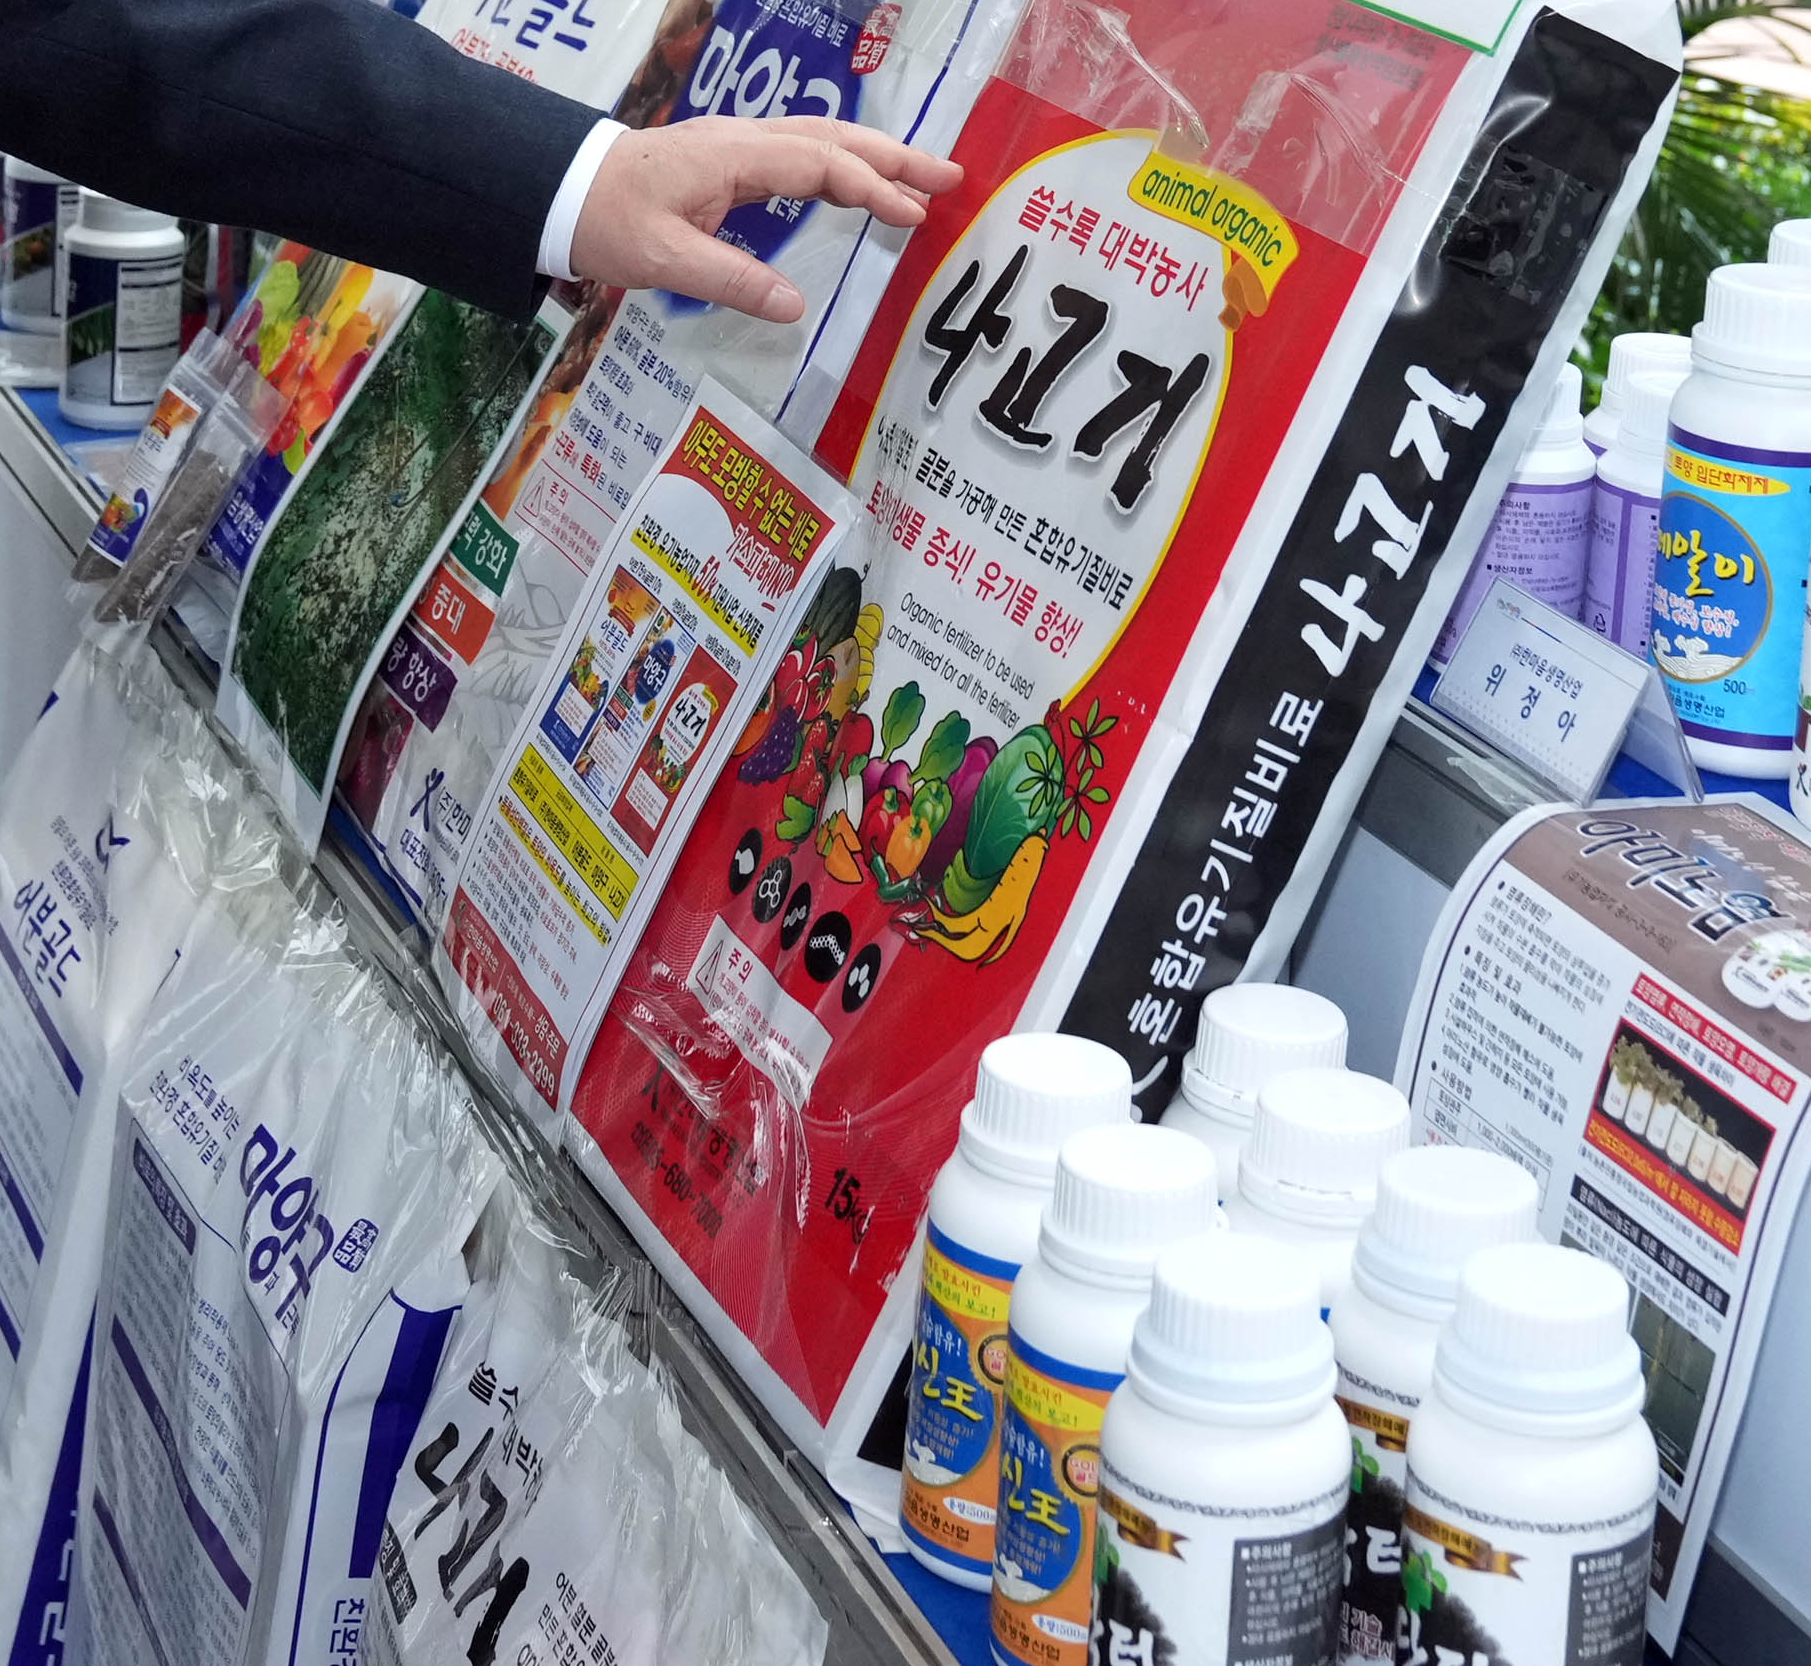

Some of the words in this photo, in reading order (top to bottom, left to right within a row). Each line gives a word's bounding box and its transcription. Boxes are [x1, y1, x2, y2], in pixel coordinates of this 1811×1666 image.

[1018, 185, 1100, 254] 쓸수록
[1098, 221, 1208, 310] 대박농사
[1141, 164, 1212, 224] animal
[1210, 194, 1283, 269] organic
[924, 242, 1211, 512] 나고기
[683, 420, 726, 475] 아무도
[711, 447, 763, 510] 모방할
[748, 477, 773, 519] 수
[757, 488, 795, 544] 없는
[914, 447, 956, 498] 골분을
[954, 478, 998, 523] 가공해
[993, 503, 1027, 542] 만든
[1024, 517, 1133, 609] 혼합유기질비료
[1298, 363, 1487, 678] 나고기
[474, 529, 509, 580] 강화
[787, 510, 820, 574] 비료
[430, 581, 467, 635] 증대
[930, 527, 975, 588] 증식!
[978, 559, 1038, 627] 유기물
[1030, 599, 1084, 661] 향상!
[400, 648, 438, 703] 향상
[886, 623, 912, 650] and
[906, 638, 944, 672] mixed
[939, 657, 959, 682] for
[968, 677, 988, 704] the
[899, 592, 943, 634] Organic
[942, 622, 985, 662] fertilizer
[994, 659, 1011, 683] be
[1008, 671, 1035, 700] used
[1483, 662, 1508, 700] 위
[1520, 687, 1543, 723] 정
[1554, 709, 1578, 745] 아
